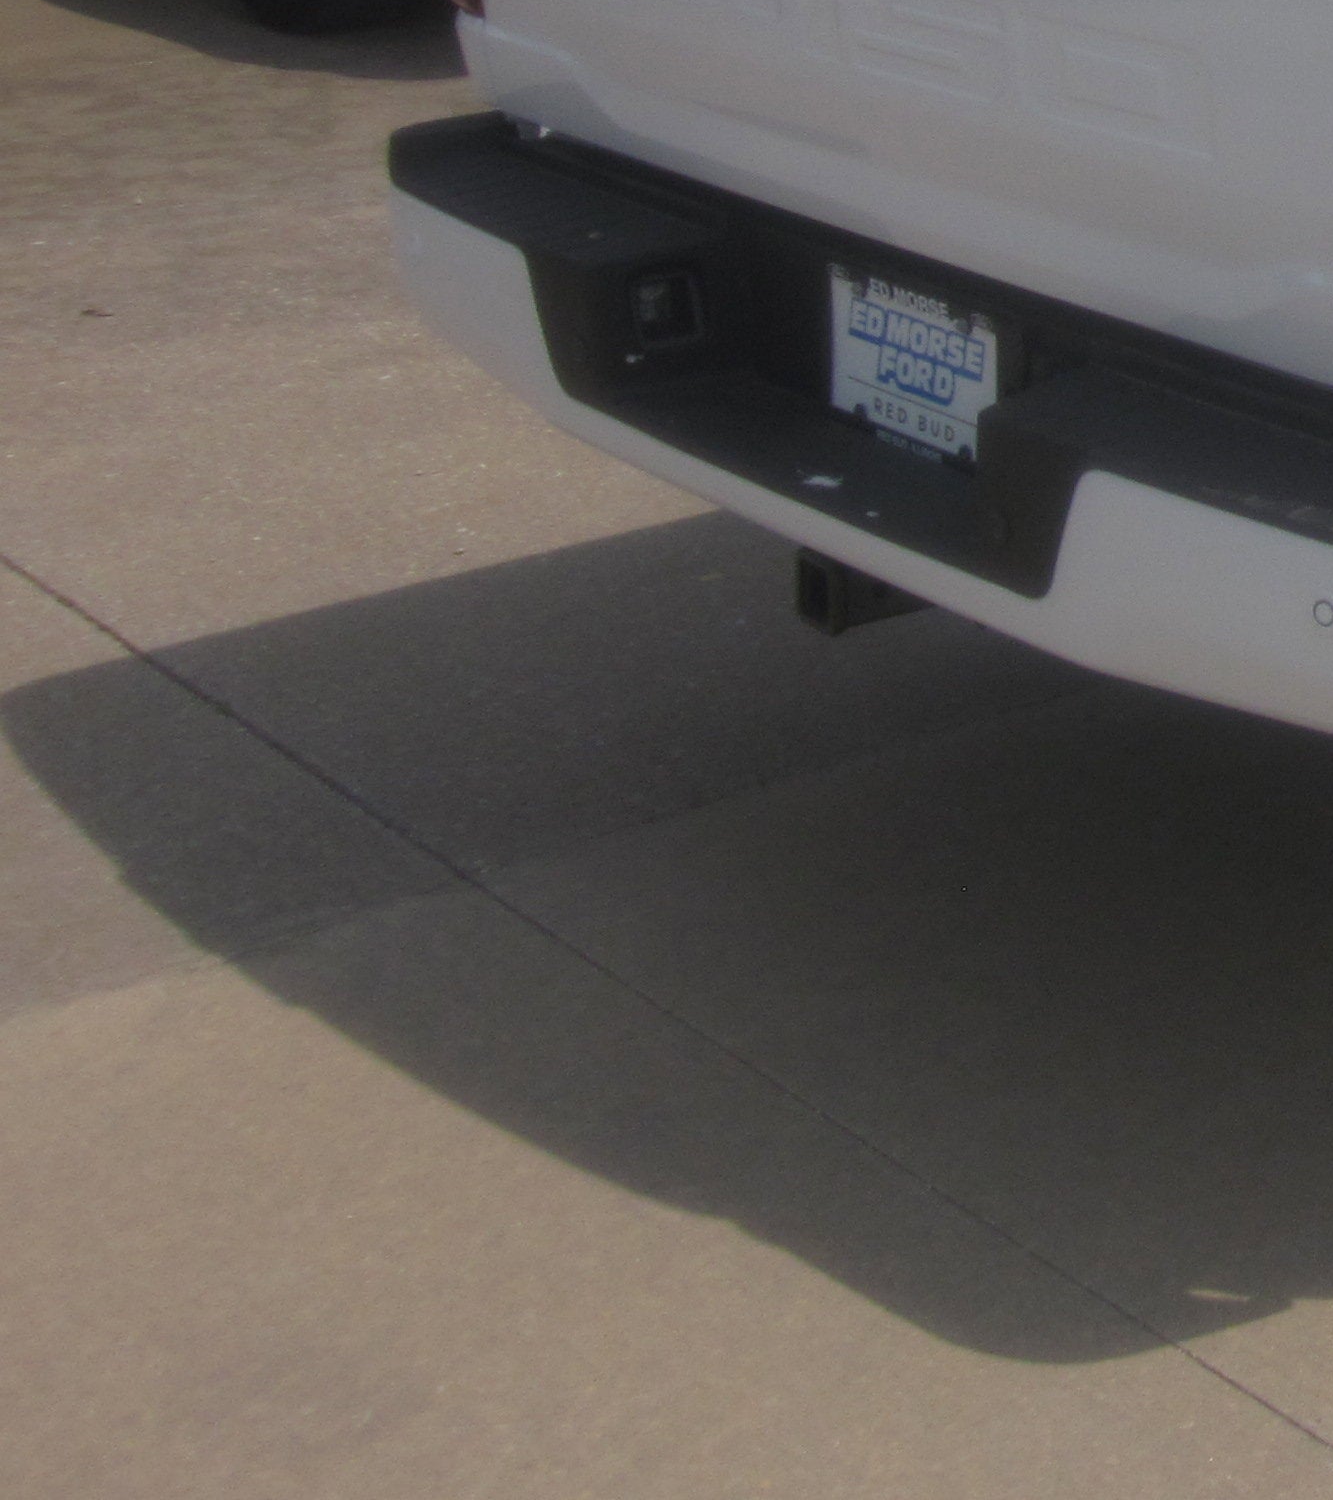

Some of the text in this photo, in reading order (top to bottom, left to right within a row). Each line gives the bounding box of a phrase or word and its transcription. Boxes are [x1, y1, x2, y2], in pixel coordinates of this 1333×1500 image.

[851, 300, 985, 374] ED MORSE
[879, 345, 955, 402] FORD
[873, 397, 955, 443] RED BUD
